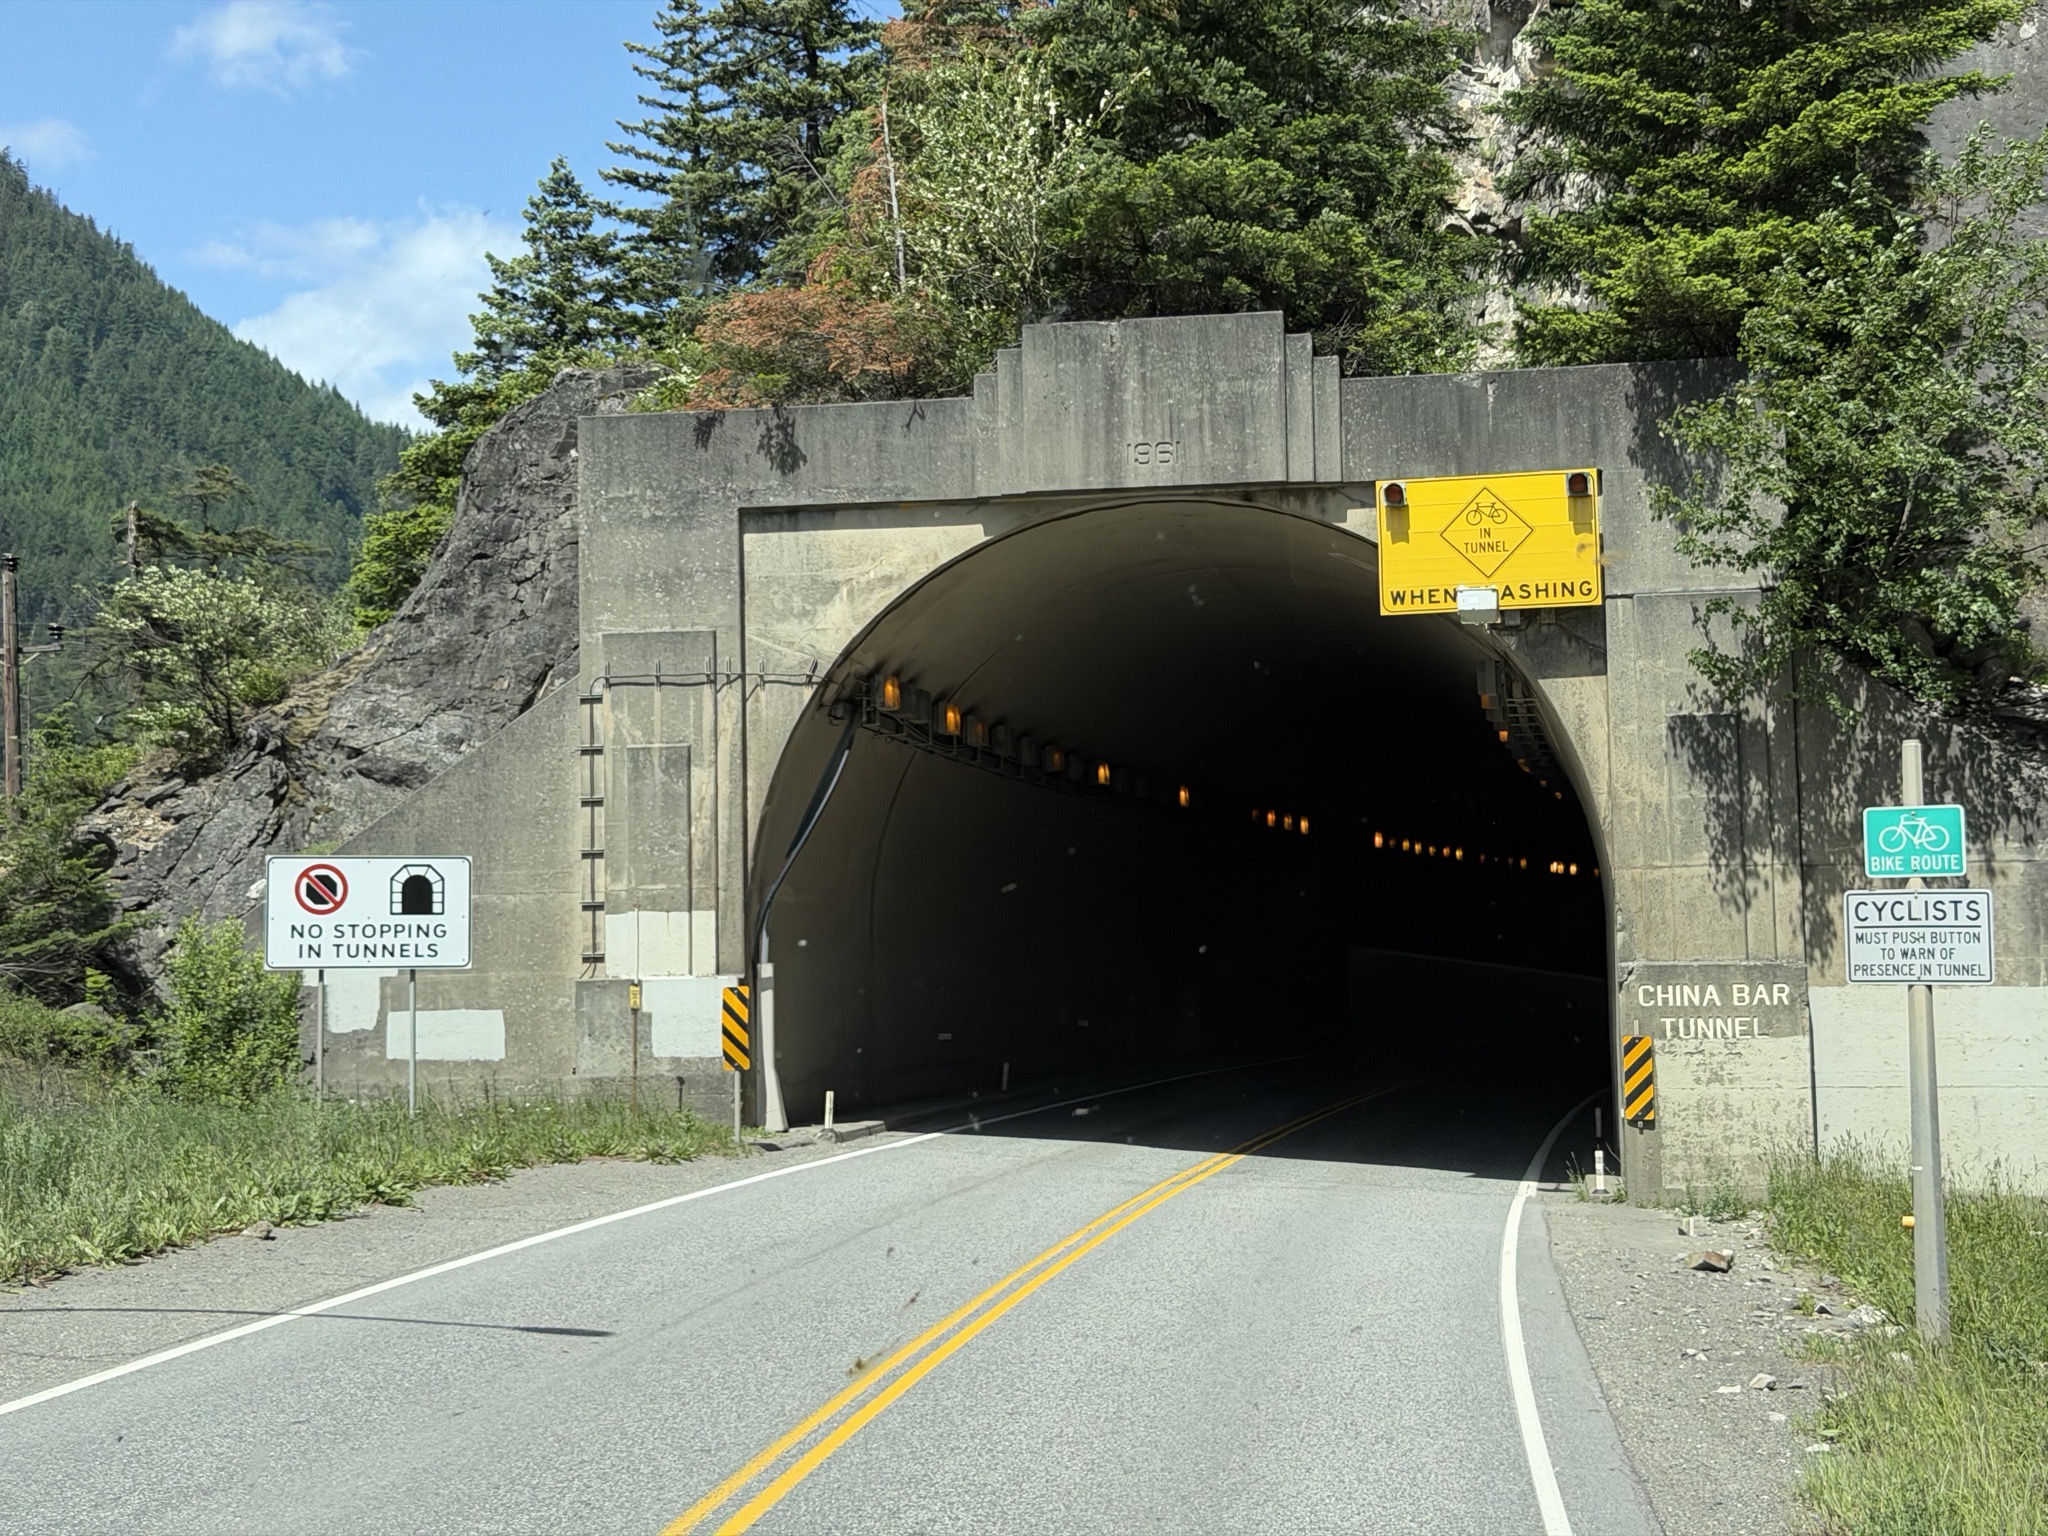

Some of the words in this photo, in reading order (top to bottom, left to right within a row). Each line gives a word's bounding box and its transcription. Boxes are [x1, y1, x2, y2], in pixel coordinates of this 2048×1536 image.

[1126, 441, 1181, 465] 1961
[1479, 527, 1491, 540] IN
[1464, 541, 1510, 554] TUNNEL
[1390, 588, 1457, 606] WHEN
[1500, 580, 1593, 601] ASHING
[1871, 856, 1904, 872] BIKE
[1910, 854, 1960, 870] ROUTE
[1854, 900, 1981, 922] CYCLISTS
[290, 924, 323, 939] NO
[333, 923, 447, 938] STOPPING
[1855, 932, 1888, 944] MUST
[1892, 931, 1926, 944] PUSH
[1930, 931, 1981, 944] BUTTON
[298, 944, 322, 959] IN
[332, 943, 439, 958] TUNNELS
[1881, 948, 1896, 960] TO
[1900, 947, 1936, 960] WARN
[1940, 947, 1956, 960] OF
[1854, 964, 1914, 976] PRESENCE
[1920, 964, 1932, 976] IN
[1936, 964, 1985, 976] TUNNEL
[1638, 984, 1721, 1007] CHINA
[1732, 983, 1790, 1006] BAR
[1660, 1016, 1770, 1039] TUNNEL
